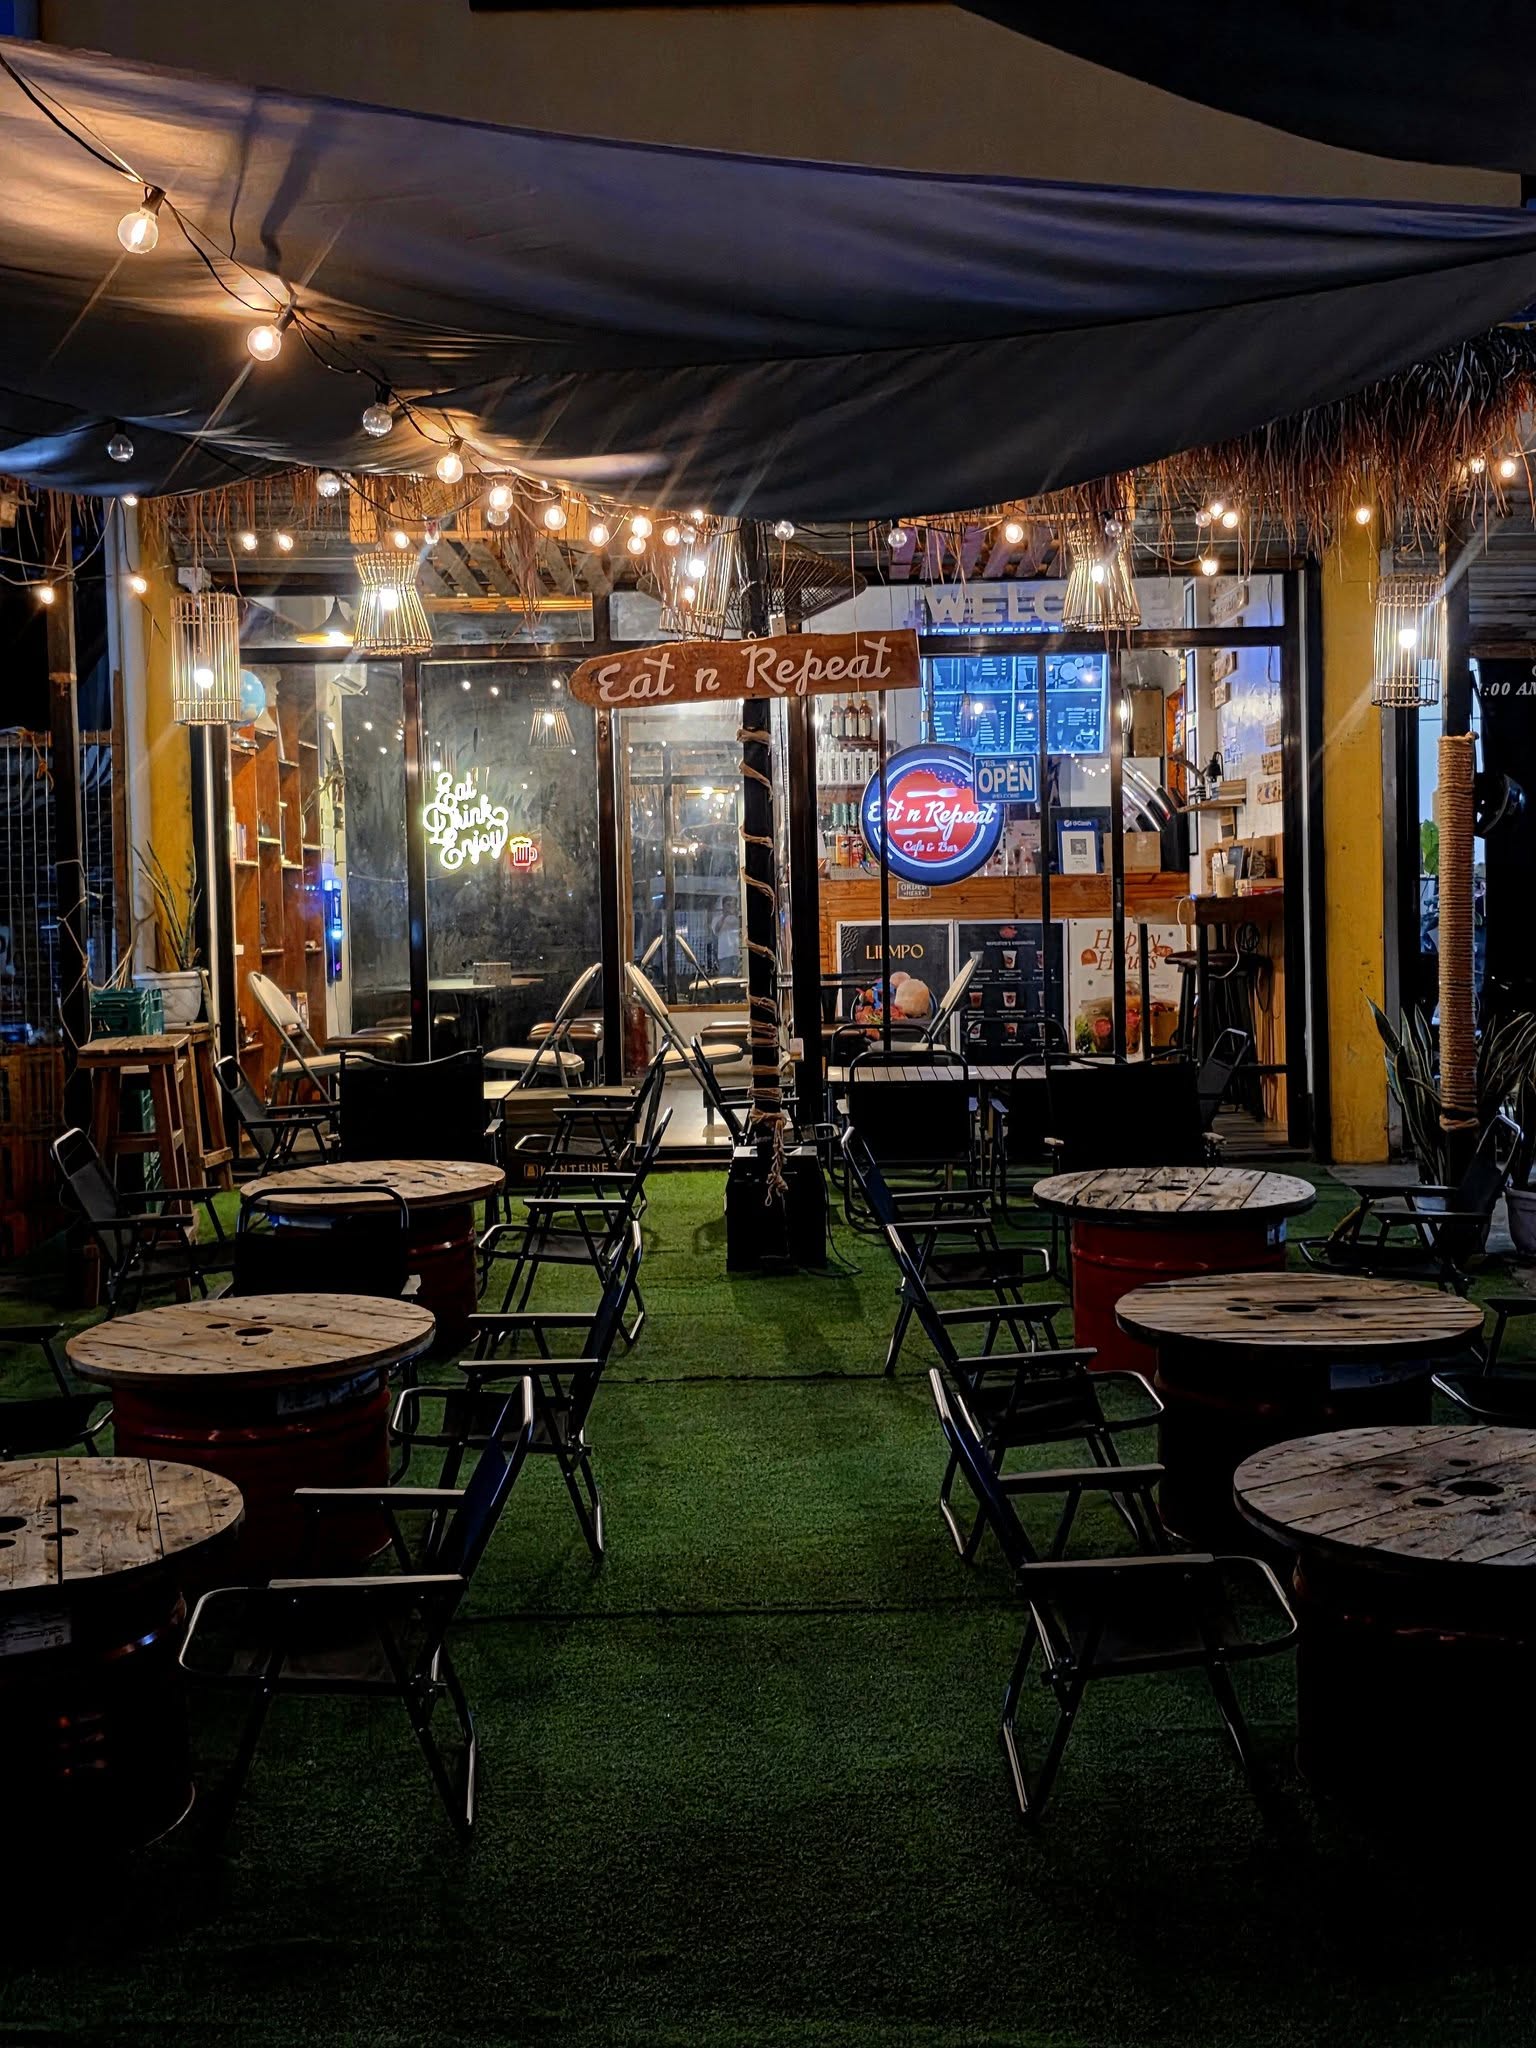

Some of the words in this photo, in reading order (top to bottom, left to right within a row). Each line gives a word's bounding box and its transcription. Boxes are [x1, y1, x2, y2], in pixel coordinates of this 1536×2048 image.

[924, 583, 1067, 624] WELC
[599, 652, 675, 702] Eat
[695, 668, 720, 693] n
[741, 636, 892, 696] Repeat
[1480, 682, 1510, 696] :00
[435, 772, 477, 814] Eat
[978, 766, 1033, 793] OPEN
[867, 799, 904, 823] Eat
[906, 807, 921, 822] n
[925, 800, 998, 841] Repeat
[440, 825, 508, 870] Enjoy
[903, 840, 925, 856] Cafe
[938, 841, 959, 853] Bar
[866, 944, 924, 959] LIMPO
[1093, 928, 1161, 954] Hpy
[1096, 950, 1158, 970] Hus
